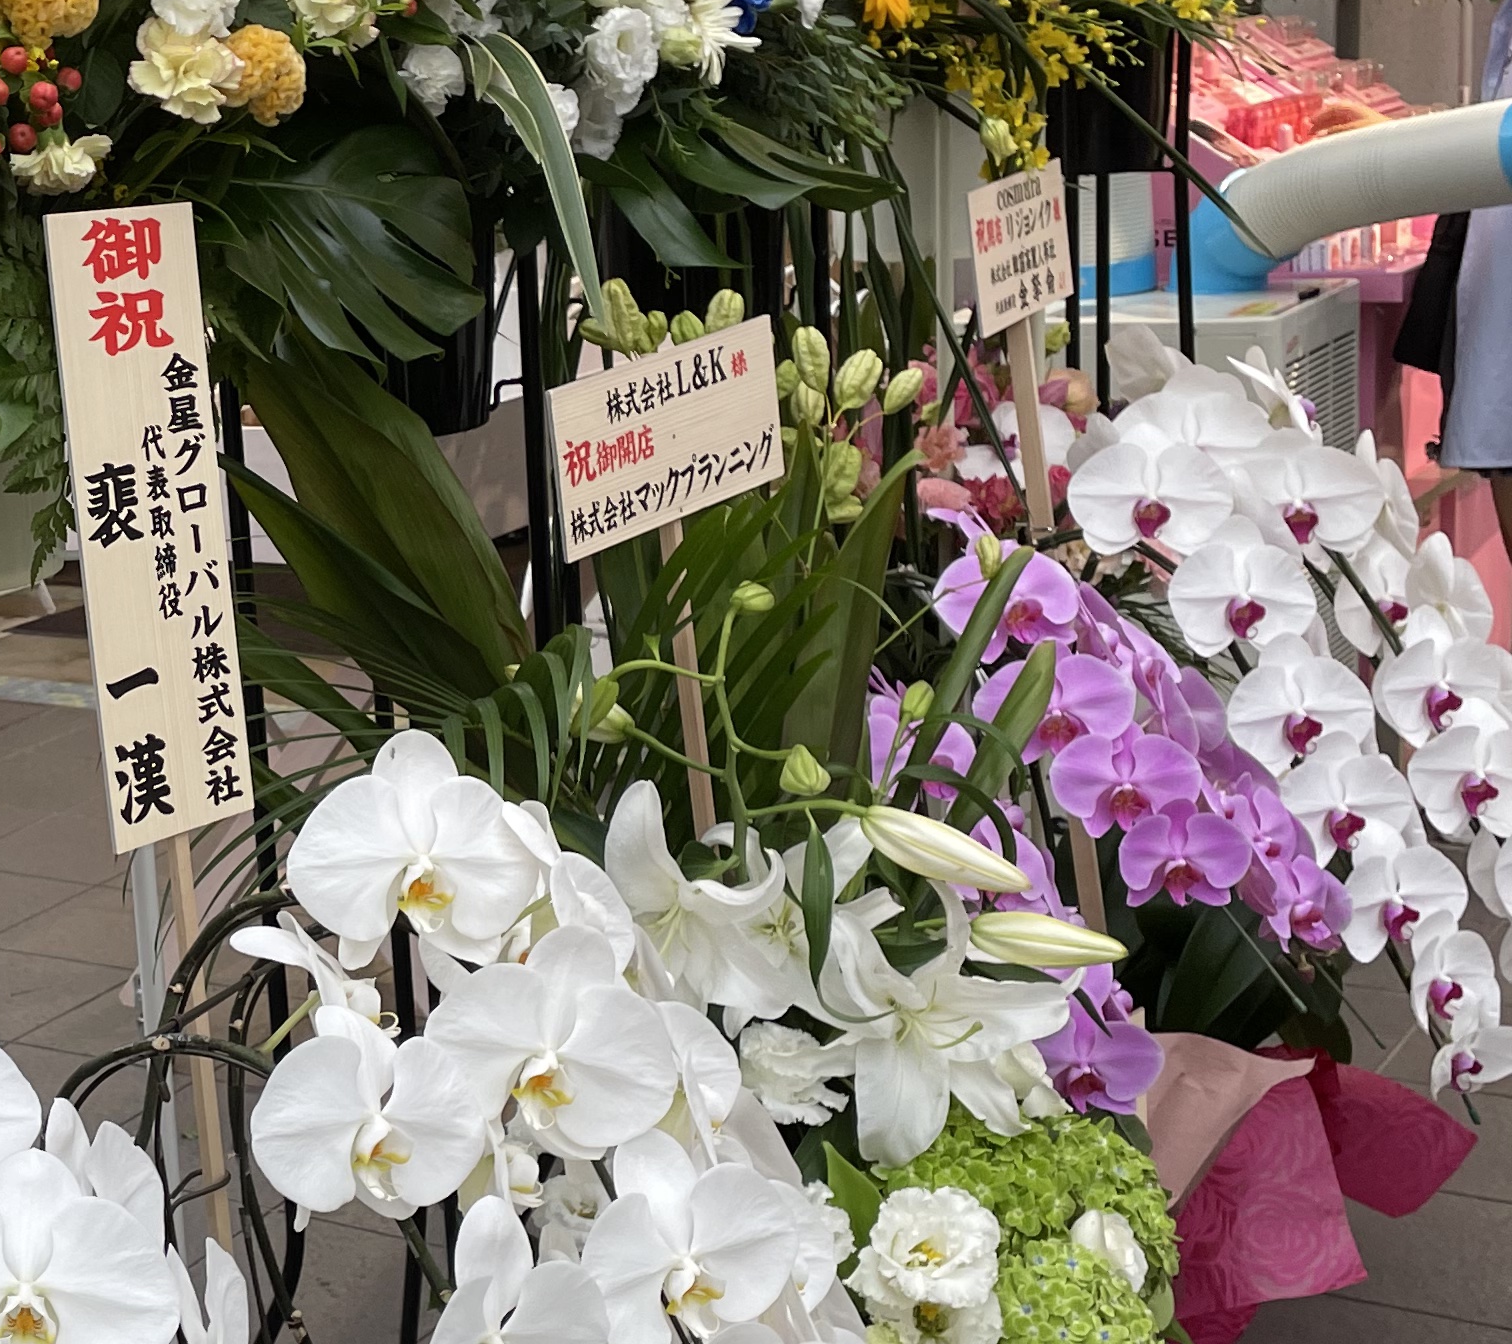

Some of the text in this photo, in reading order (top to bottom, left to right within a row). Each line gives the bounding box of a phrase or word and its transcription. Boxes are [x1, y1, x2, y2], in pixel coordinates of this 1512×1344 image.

[81, 216, 174, 356] 御祝
[606, 345, 728, 425] 株式会社L&K
[141, 424, 185, 620] 代表取締役
[570, 423, 775, 545] 株式会社マックプランニング
[160, 352, 244, 807] 金星グローバル株式会社
